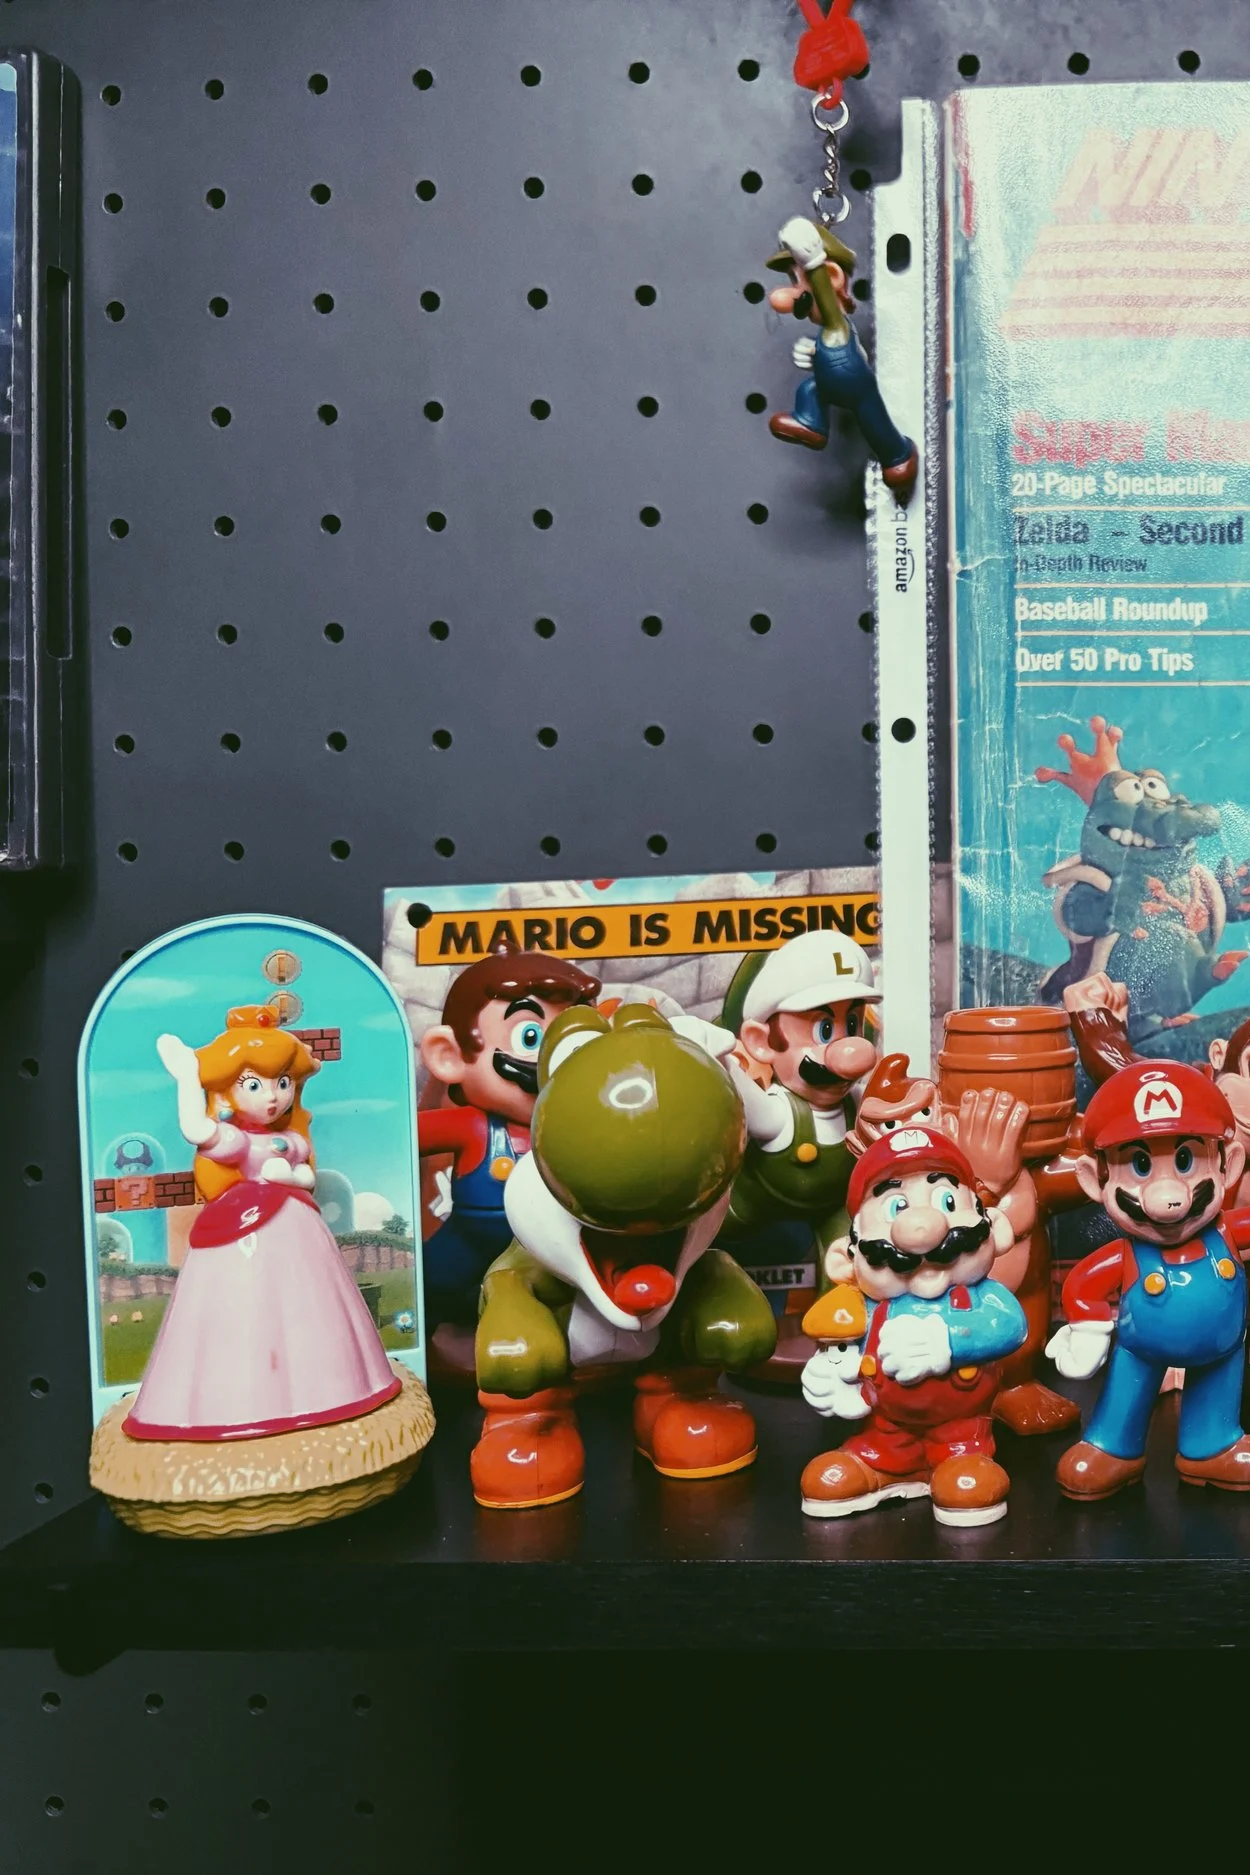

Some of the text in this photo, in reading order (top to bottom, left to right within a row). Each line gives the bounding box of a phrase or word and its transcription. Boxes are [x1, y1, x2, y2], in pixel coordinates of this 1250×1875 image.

[1012, 408, 1151, 469] Super
[1011, 471, 1228, 500] 20-Page Spectacular
[1014, 513, 1090, 545] Zelda
[1139, 514, 1244, 545] Second
[894, 526, 908, 593] amazon
[1088, 554, 1148, 573] Review
[1015, 597, 1208, 627] Baseball Roundup
[1015, 647, 1195, 676] Over 50 Pro Tips
[438, 901, 881, 956] MARIO IS MISSING
[832, 951, 855, 976] L
[1143, 1088, 1178, 1115] M
[903, 1130, 920, 1145] M
